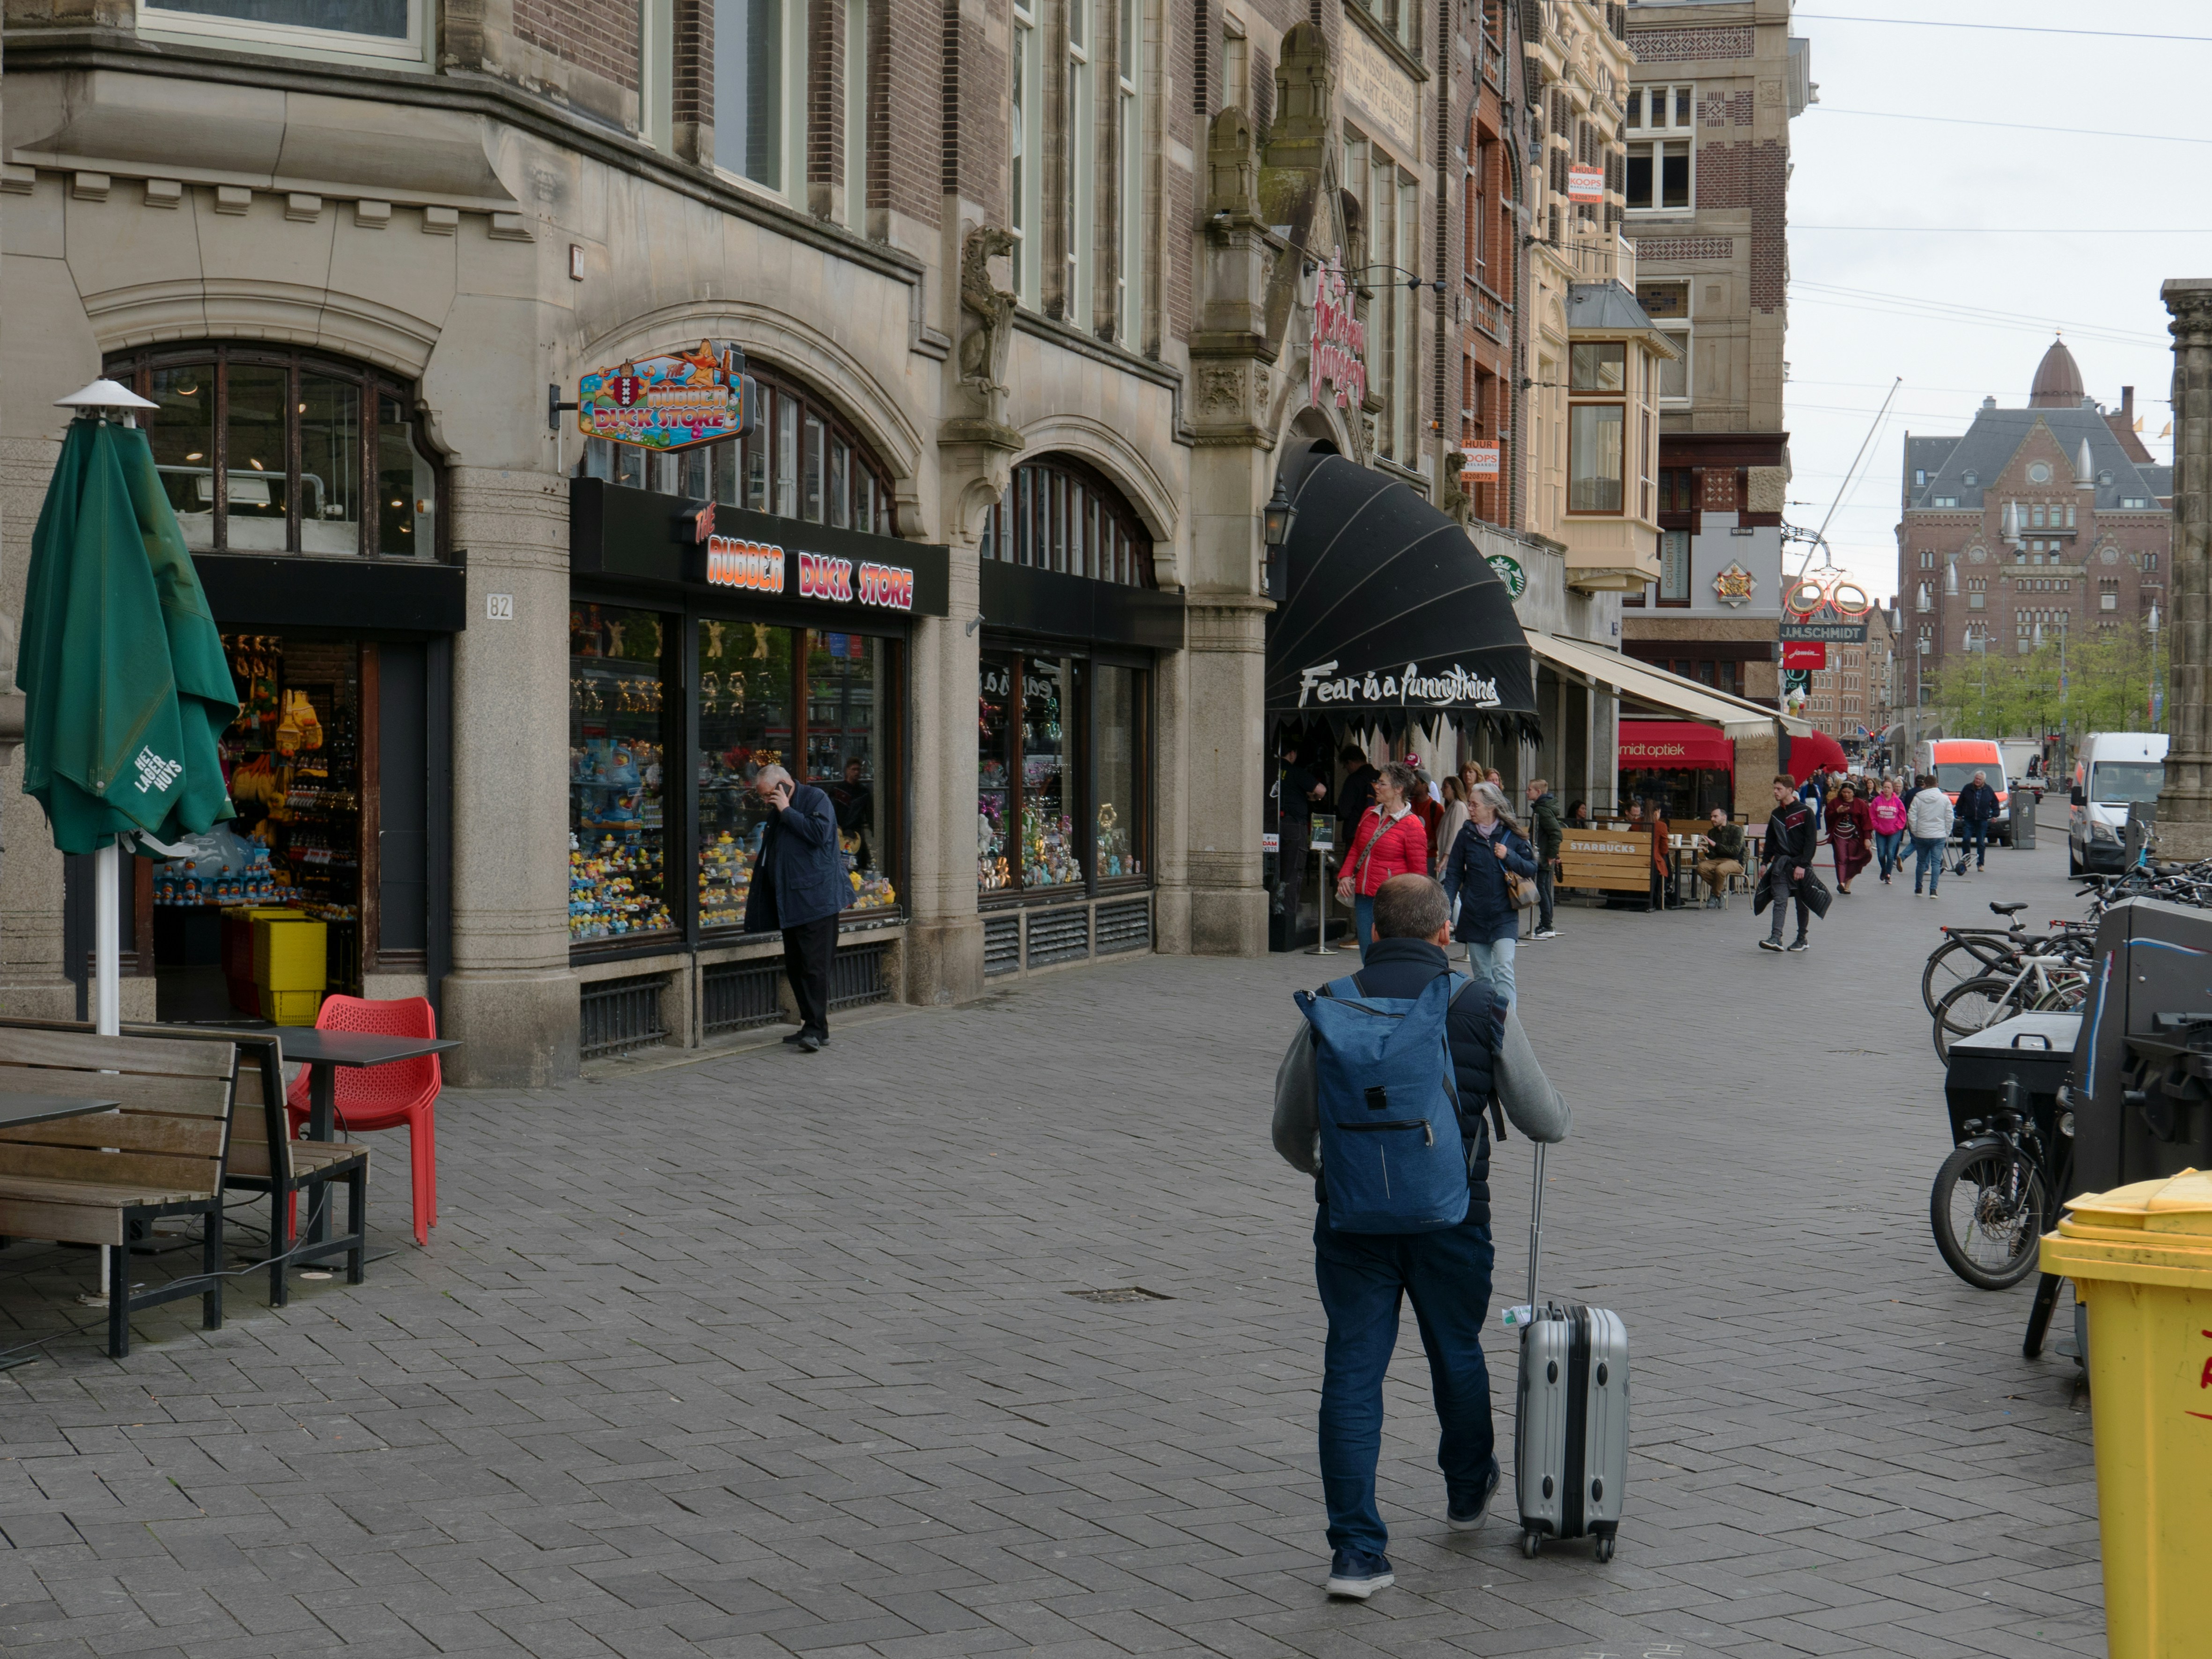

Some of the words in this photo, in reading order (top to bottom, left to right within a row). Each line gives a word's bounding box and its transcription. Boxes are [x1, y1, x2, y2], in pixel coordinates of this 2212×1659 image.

[1362, 46, 1403, 98] WISSELINGH
[1343, 55, 1361, 90] FINE
[1364, 75, 1379, 106] ART
[1382, 92, 1412, 136] GALLERY
[1570, 178, 1601, 187] KOOPS
[666, 362, 687, 378] THE
[647, 384, 729, 408] RUBBER
[593, 407, 655, 429] DUCK
[657, 407, 727, 429] STORE
[1466, 454, 1497, 463] OOPS
[695, 501, 716, 545] THE
[707, 534, 785, 594] RUBBER
[798, 550, 853, 603] DUCK
[859, 562, 914, 610] STORE
[1664, 539, 1674, 589] oculenti
[490, 596, 509, 617] 82
[1298, 660, 1361, 708] Fear
[1363, 671, 1382, 700] is
[1383, 676, 1399, 697] a
[134, 745, 154, 771] HET
[1619, 743, 1646, 755] midt
[1647, 743, 1685, 758] optiek
[134, 755, 167, 793] LAGER
[154, 759, 183, 792] HUYS
[1570, 842, 1636, 853] STARBUCKS
